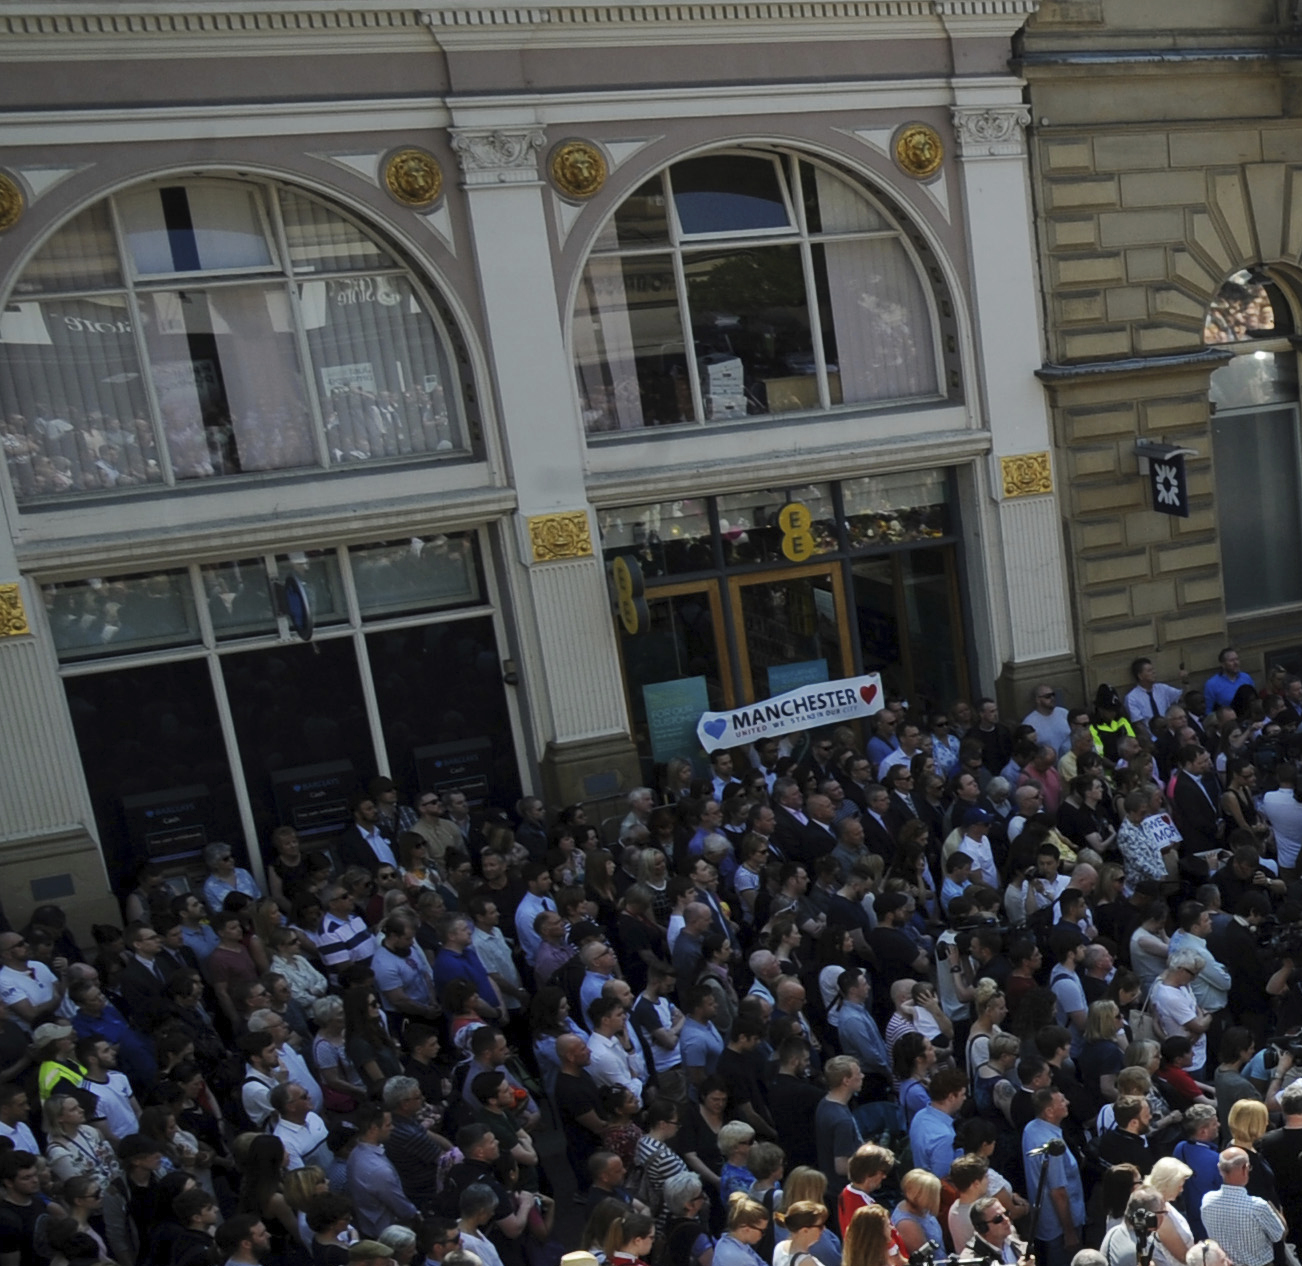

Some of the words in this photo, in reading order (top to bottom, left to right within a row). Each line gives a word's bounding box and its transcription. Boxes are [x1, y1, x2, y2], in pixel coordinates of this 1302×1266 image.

[732, 688, 858, 730] MANCHESTER
[735, 725, 768, 738] UNITED
[772, 720, 785, 728] WE
[825, 708, 841, 717] OUR
[843, 705, 859, 714] CITY
